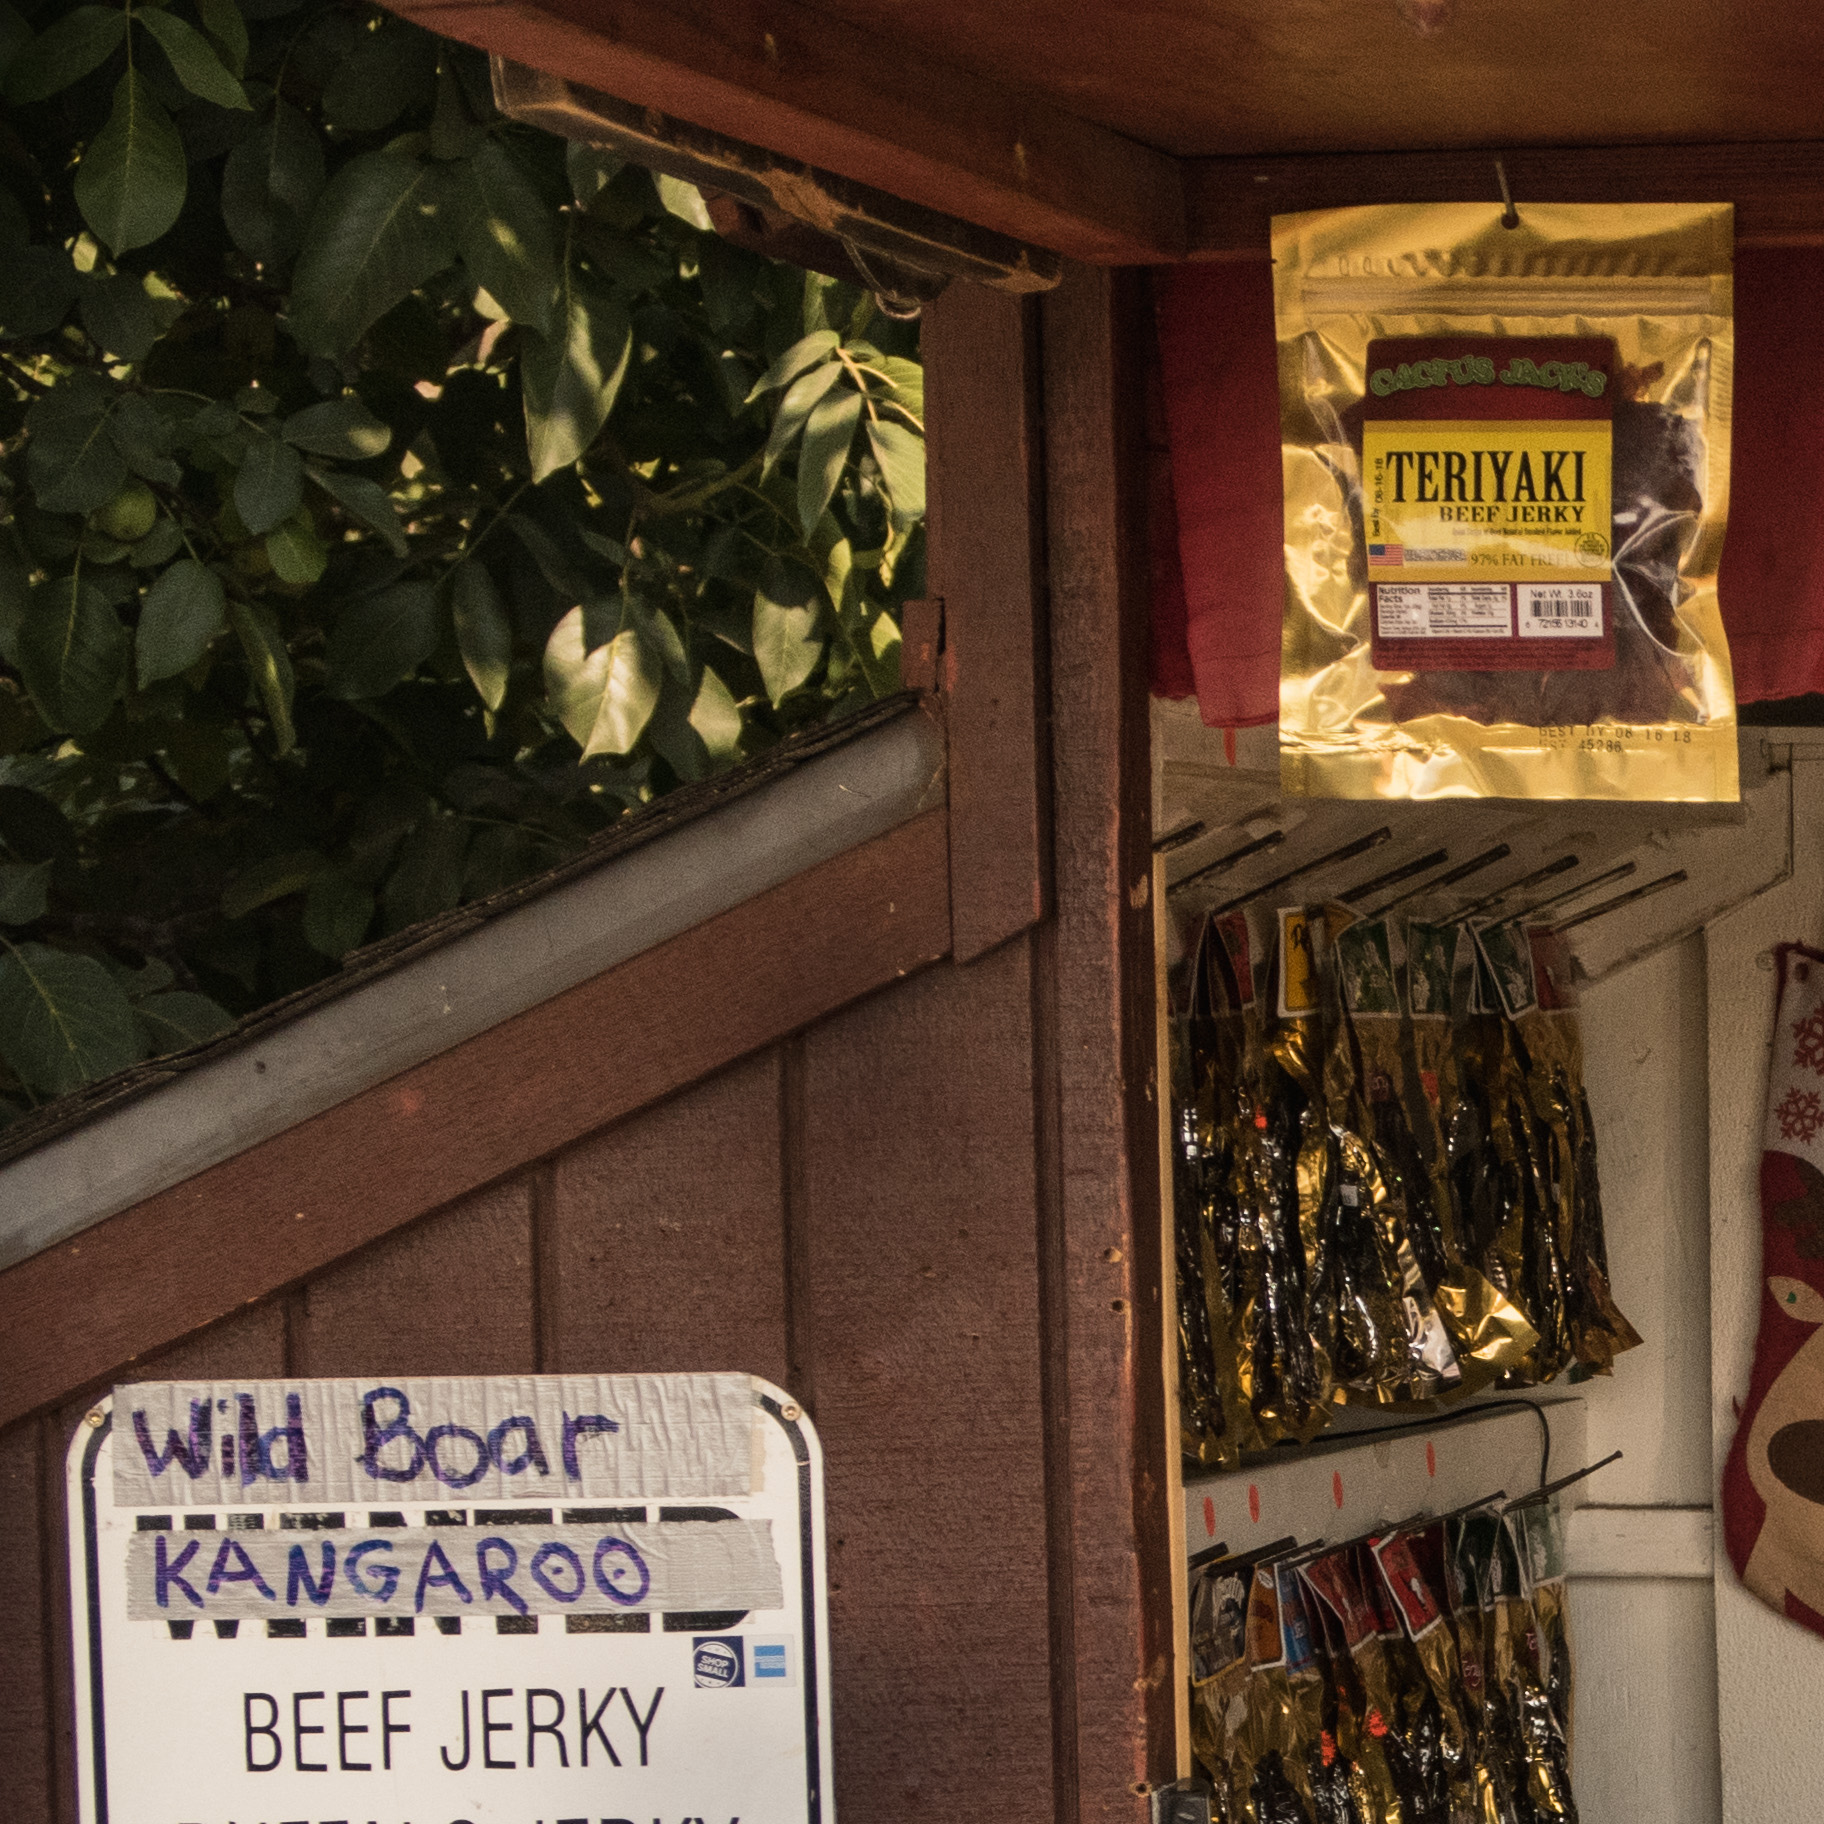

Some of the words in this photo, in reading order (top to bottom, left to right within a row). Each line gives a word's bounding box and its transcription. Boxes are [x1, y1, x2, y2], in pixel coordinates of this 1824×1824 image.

[1370, 355, 1495, 397] CACTUS
[1386, 450, 1587, 503] TERIYAKI
[1438, 505, 1500, 523] BEEF
[1505, 505, 1586, 523] JERKY
[1471, 553, 1499, 566] 97%
[1502, 553, 1526, 566] FAT
[1379, 586, 1421, 595] Nutrition
[1379, 595, 1403, 603] Facts
[1530, 589, 1546, 599] Net
[132, 1391, 309, 1488] Wild
[354, 1386, 620, 1489] Boar
[154, 1534, 651, 1616] KANGAROO
[696, 1662, 729, 1679] SMALL
[701, 1655, 729, 1669] SHOP
[243, 1691, 413, 1772] BEEF
[440, 1686, 666, 1772] JERKY
